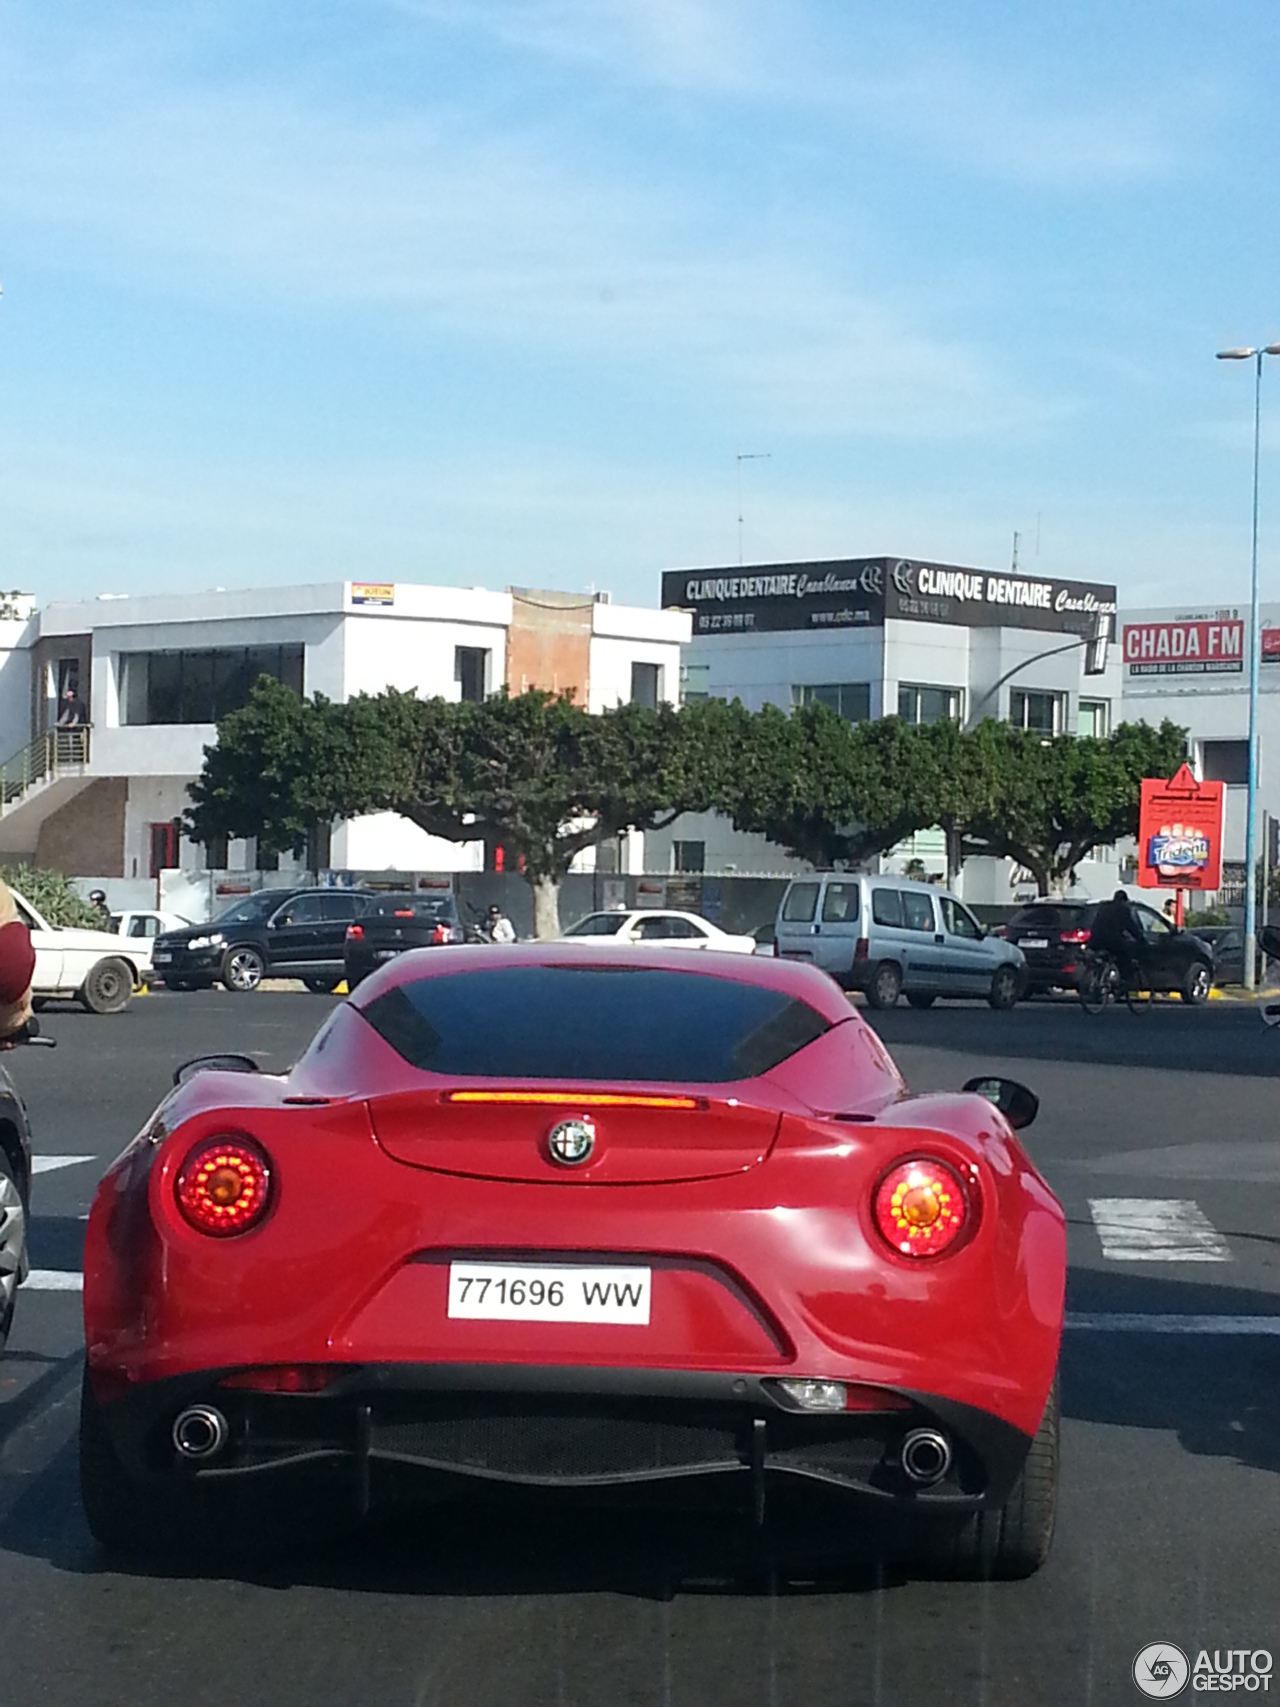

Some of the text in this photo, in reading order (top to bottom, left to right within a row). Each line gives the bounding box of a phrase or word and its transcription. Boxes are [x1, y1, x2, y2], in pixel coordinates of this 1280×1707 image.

[686, 572, 857, 602] CLINIQUE DENTAIRE Casablanca
[918, 568, 983, 602] CLINIQUE
[987, 577, 1052, 608] DENTAIRE
[1127, 627, 1200, 659] CHADA
[1207, 625, 1240, 656] FM
[1156, 841, 1206, 860] Trident
[457, 1277, 643, 1307] 771696 WW
